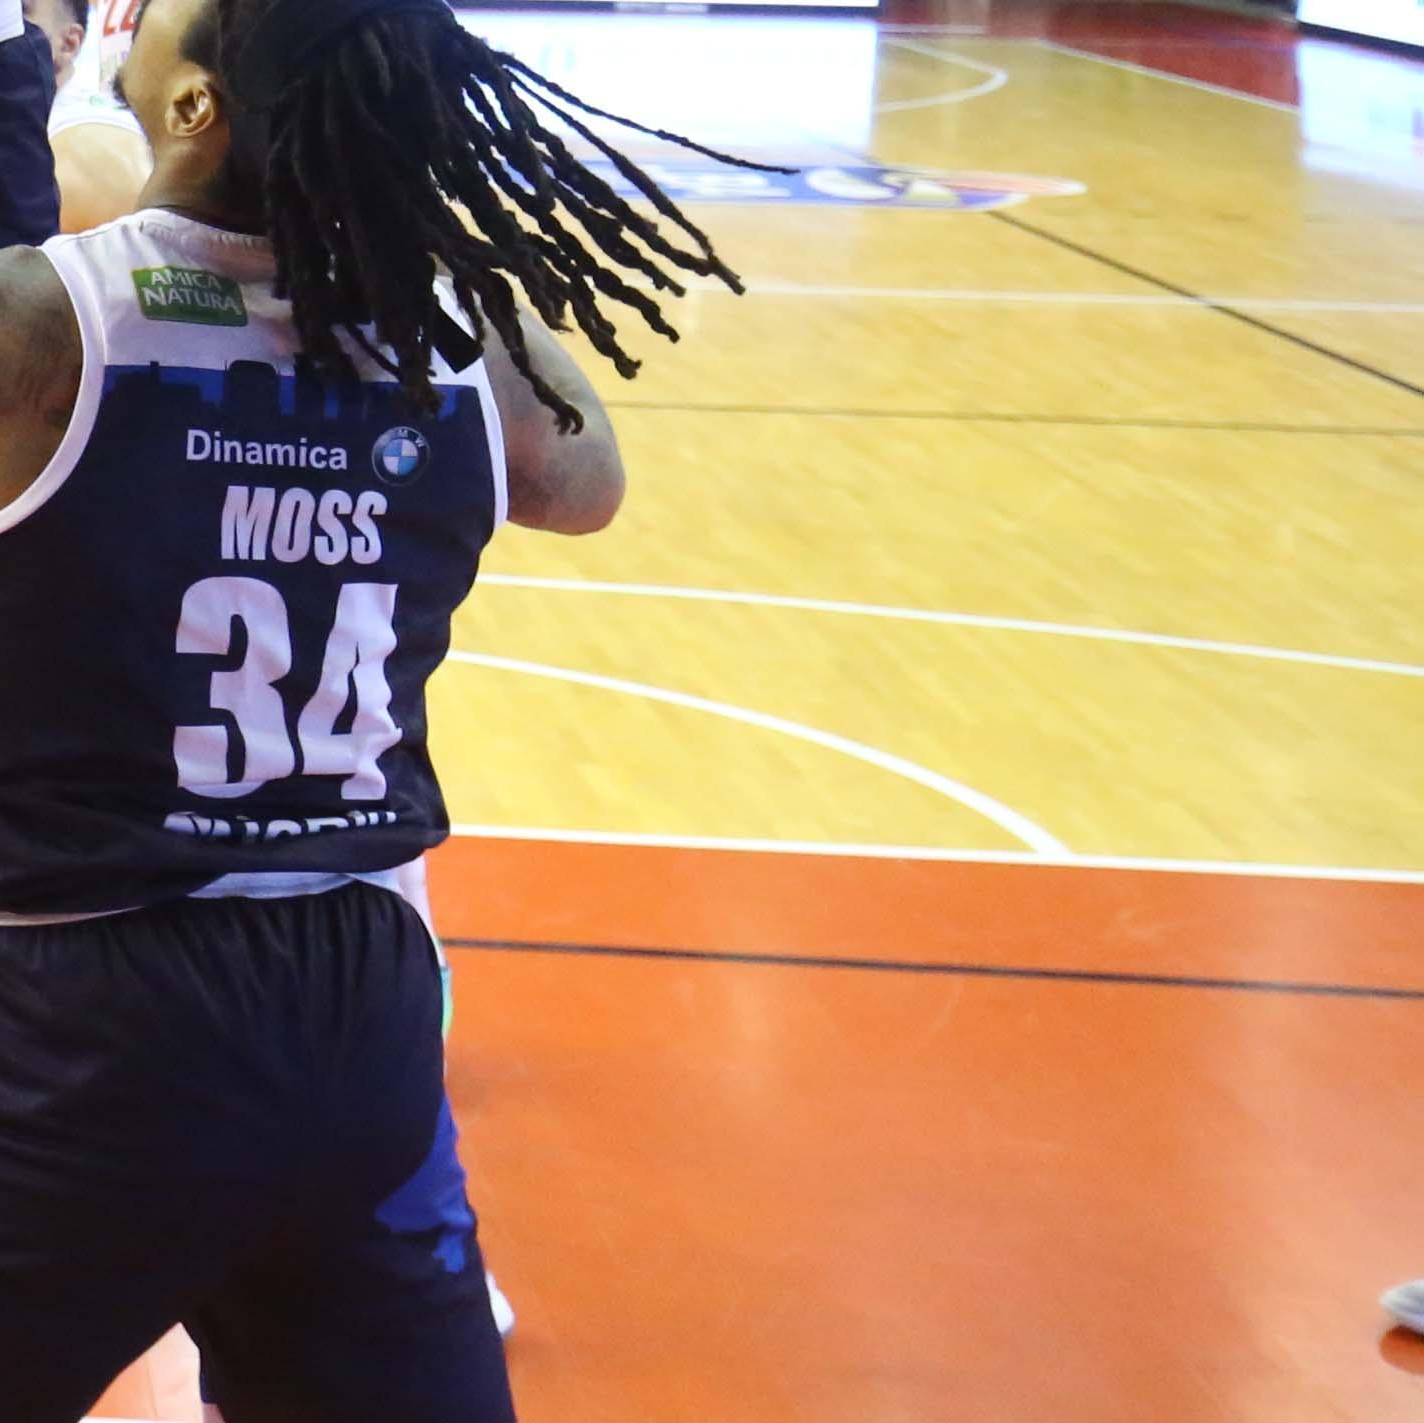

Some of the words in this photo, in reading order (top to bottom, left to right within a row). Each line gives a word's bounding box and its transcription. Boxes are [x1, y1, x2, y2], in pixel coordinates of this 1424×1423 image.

[151, 267, 222, 291] AMICA
[142, 286, 242, 316] NATURA
[186, 429, 348, 471] Dinamica
[220, 485, 388, 565] MOSS
[172, 577, 403, 801] 34
